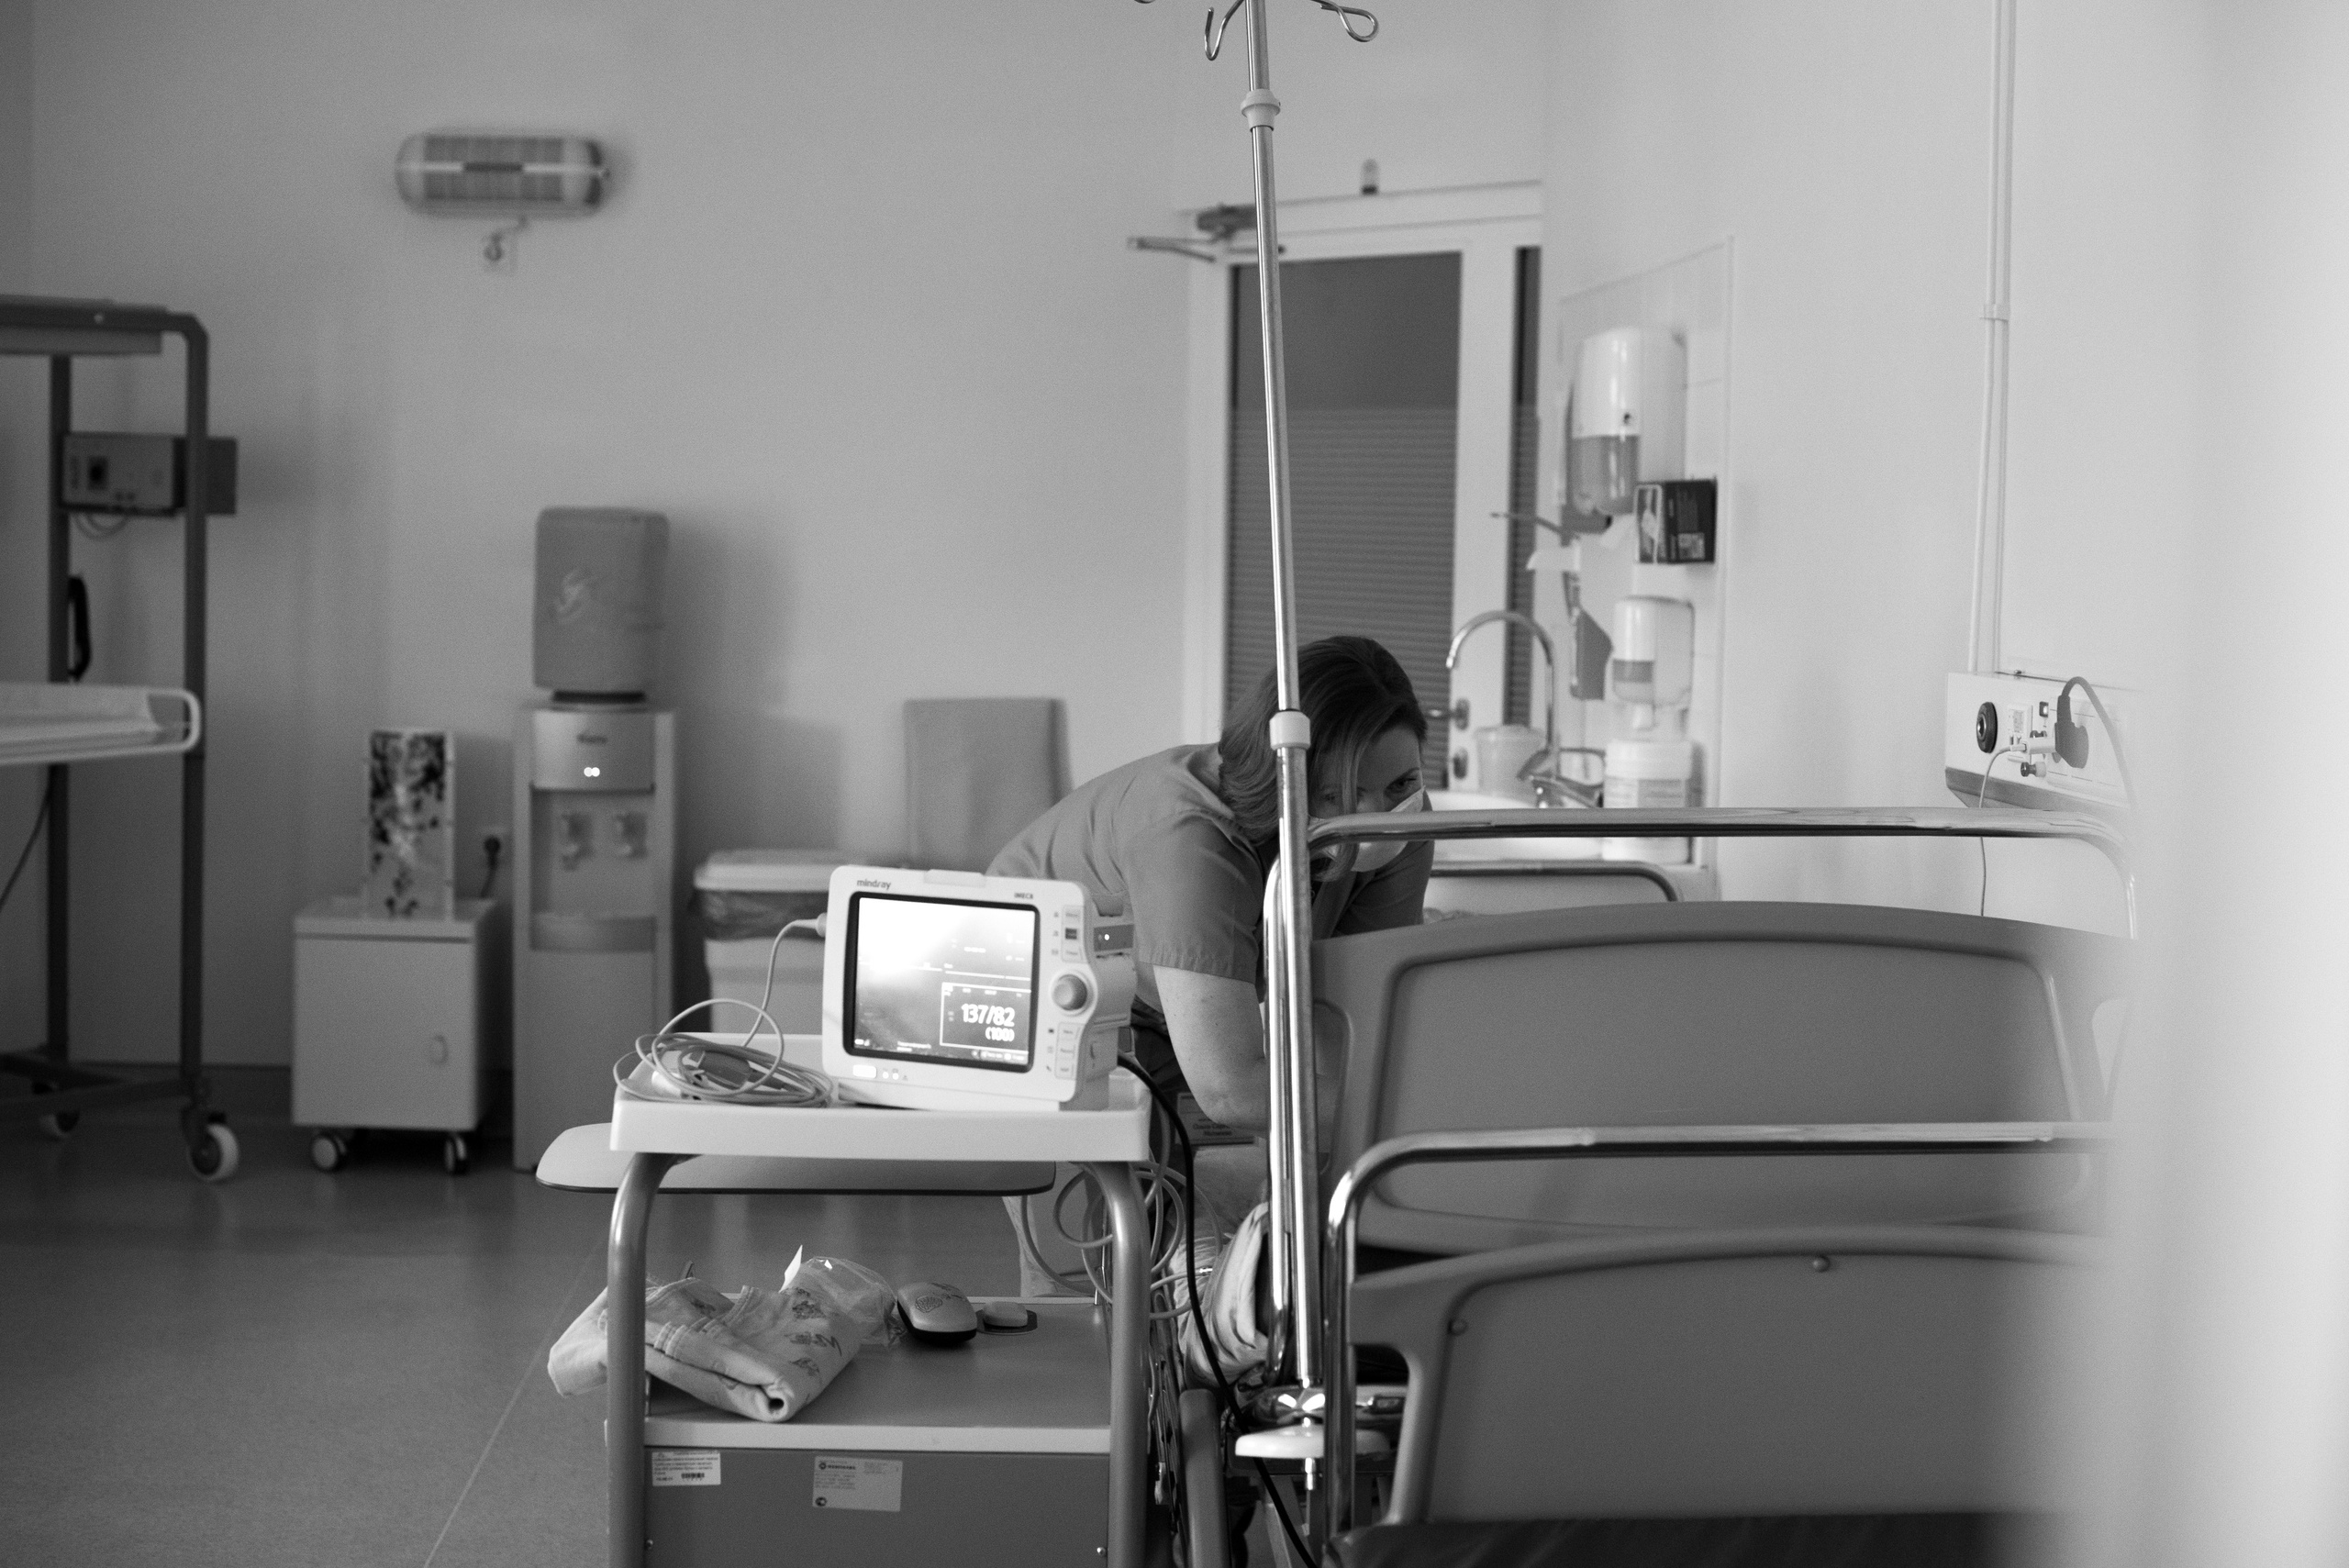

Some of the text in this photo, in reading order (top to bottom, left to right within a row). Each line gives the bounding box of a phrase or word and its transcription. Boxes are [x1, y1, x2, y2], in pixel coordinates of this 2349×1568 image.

[857, 878, 892, 890] mindray
[962, 1003, 1016, 1028] 137/82
[985, 1026, 1015, 1041] (100)
